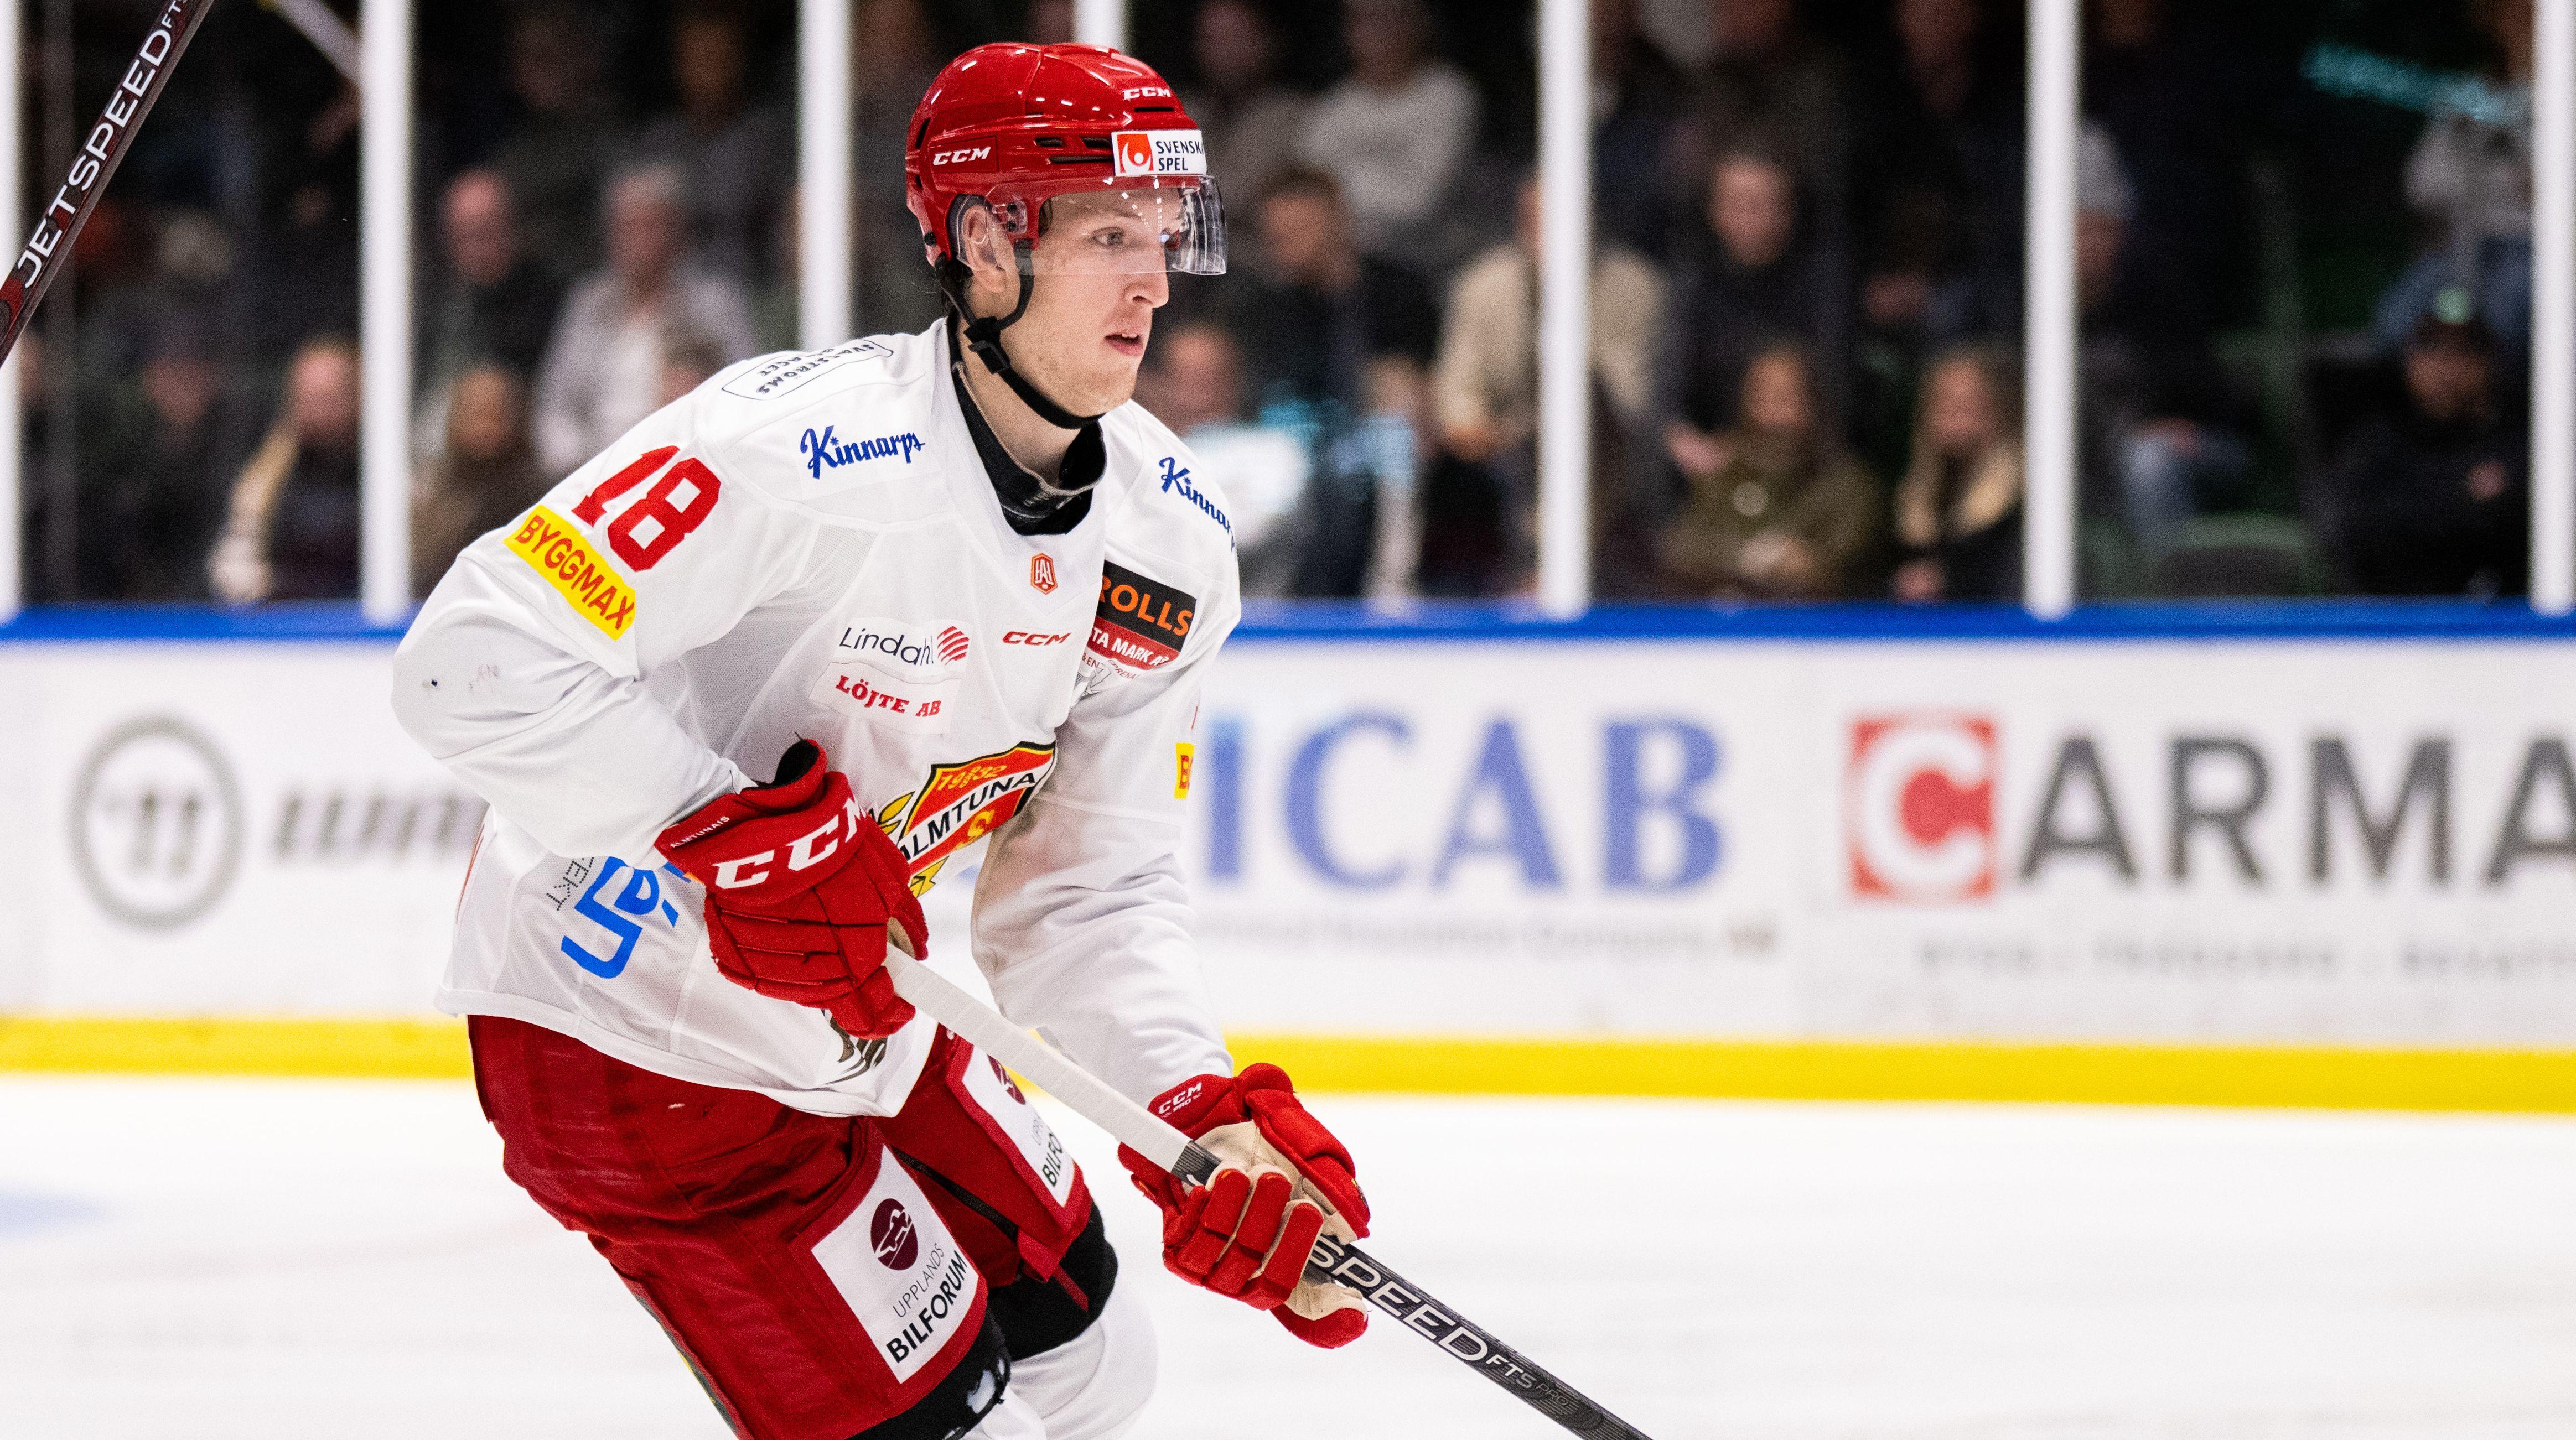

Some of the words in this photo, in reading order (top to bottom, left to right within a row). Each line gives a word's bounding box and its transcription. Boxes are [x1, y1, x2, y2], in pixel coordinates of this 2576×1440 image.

[1123, 86, 1171, 100] CCM
[18, 30, 171, 288] JETSPEED
[161, 0, 187, 28] FT
[933, 147, 991, 165] CCM
[1158, 158, 1189, 171] SPEL
[800, 425, 926, 480] Kinnarps
[571, 445, 722, 573] 18
[515, 515, 635, 630] BYGGMAX
[839, 627, 934, 666] Lindahl
[1002, 631, 1072, 646] CCM
[1111, 638, 1154, 663] MARK
[835, 675, 910, 714] LÖJTE
[915, 700, 942, 718] AB
[712, 795, 867, 890] CCM
[1158, 1082, 1202, 1114] CCM
[1173, 1098, 1192, 1113] PRO
[892, 1243, 944, 1318] UPPLANDS
[885, 1250, 968, 1364] BILFORUM
[1485, 1354, 1537, 1389] FTS
